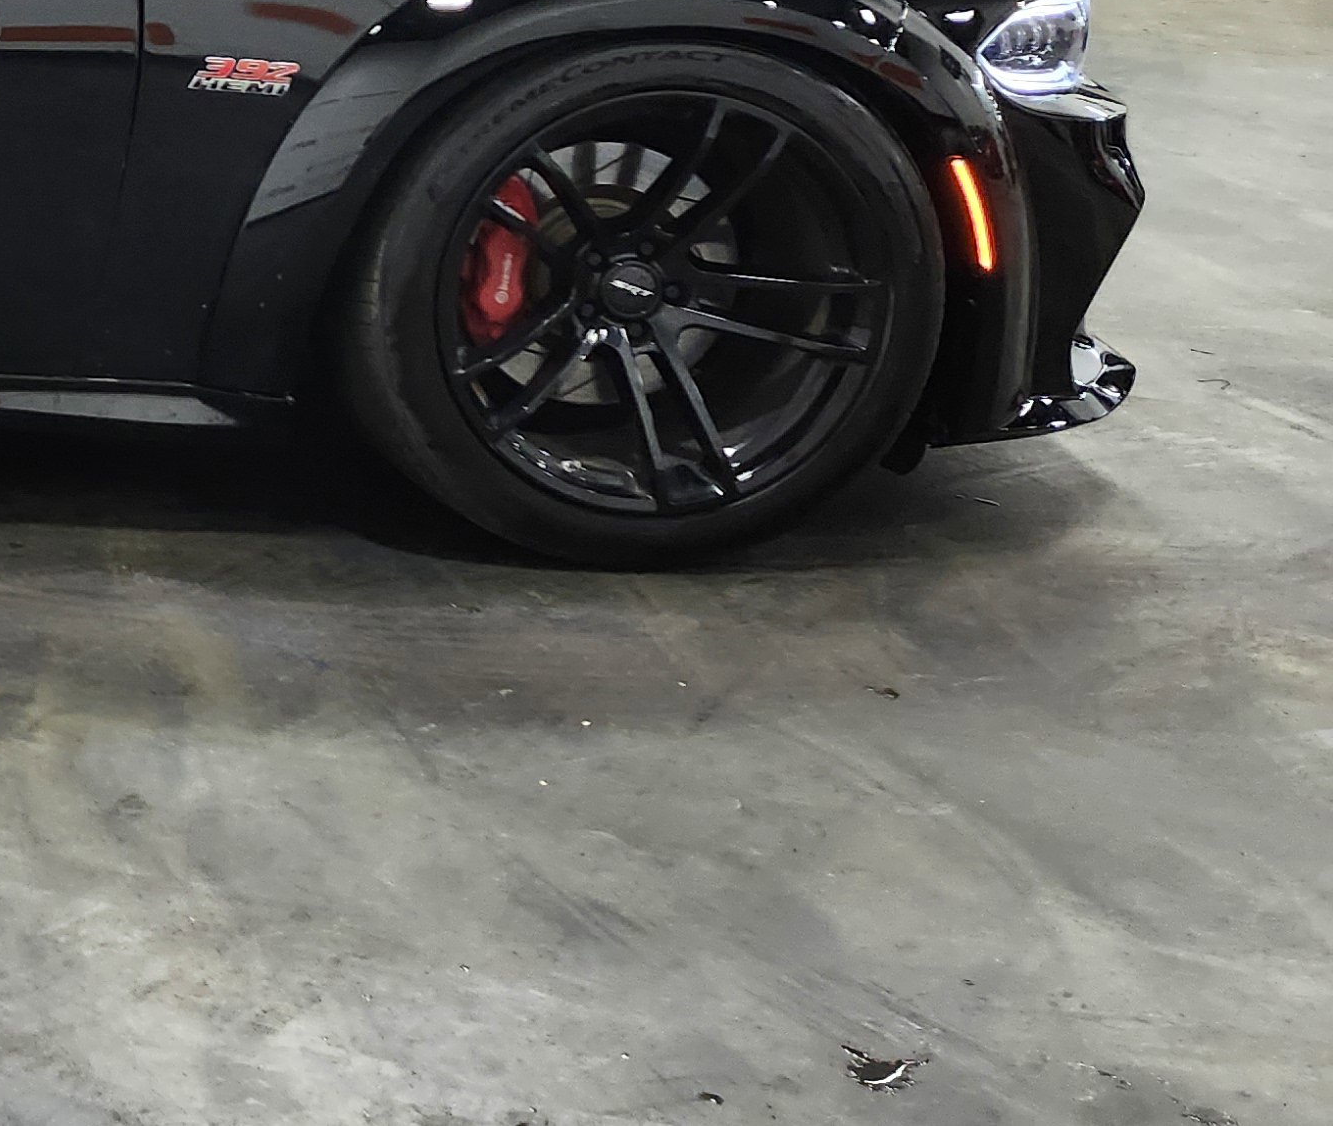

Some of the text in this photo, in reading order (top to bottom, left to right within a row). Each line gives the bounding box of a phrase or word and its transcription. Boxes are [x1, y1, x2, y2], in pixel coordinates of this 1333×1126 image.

[195, 56, 300, 83] 392
[187, 75, 290, 96] HEMI
[608, 278, 655, 297] SRT
